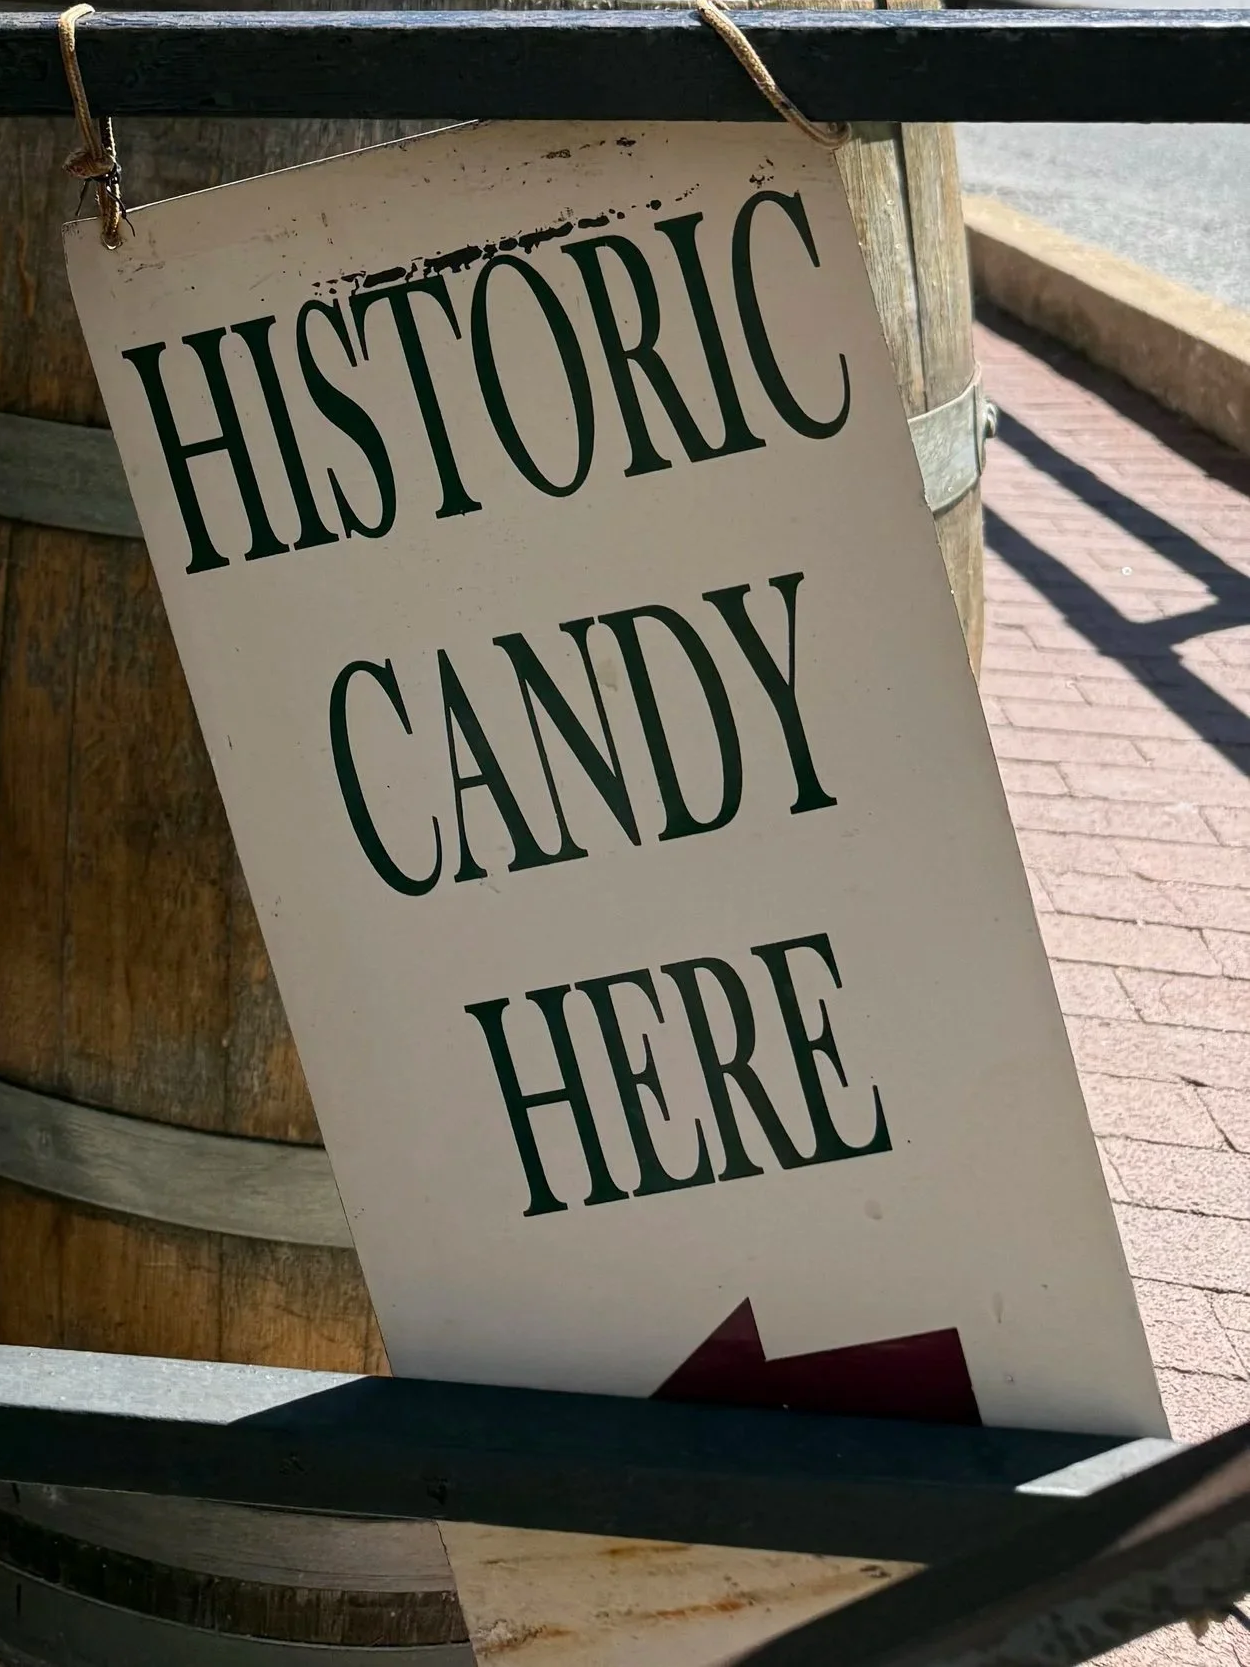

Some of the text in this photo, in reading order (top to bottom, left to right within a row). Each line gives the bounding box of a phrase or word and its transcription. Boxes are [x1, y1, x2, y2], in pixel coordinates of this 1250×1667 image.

[123, 190, 852, 575] HISTORIC
[328, 571, 838, 897] CANDY
[464, 932, 893, 1217] HERE
